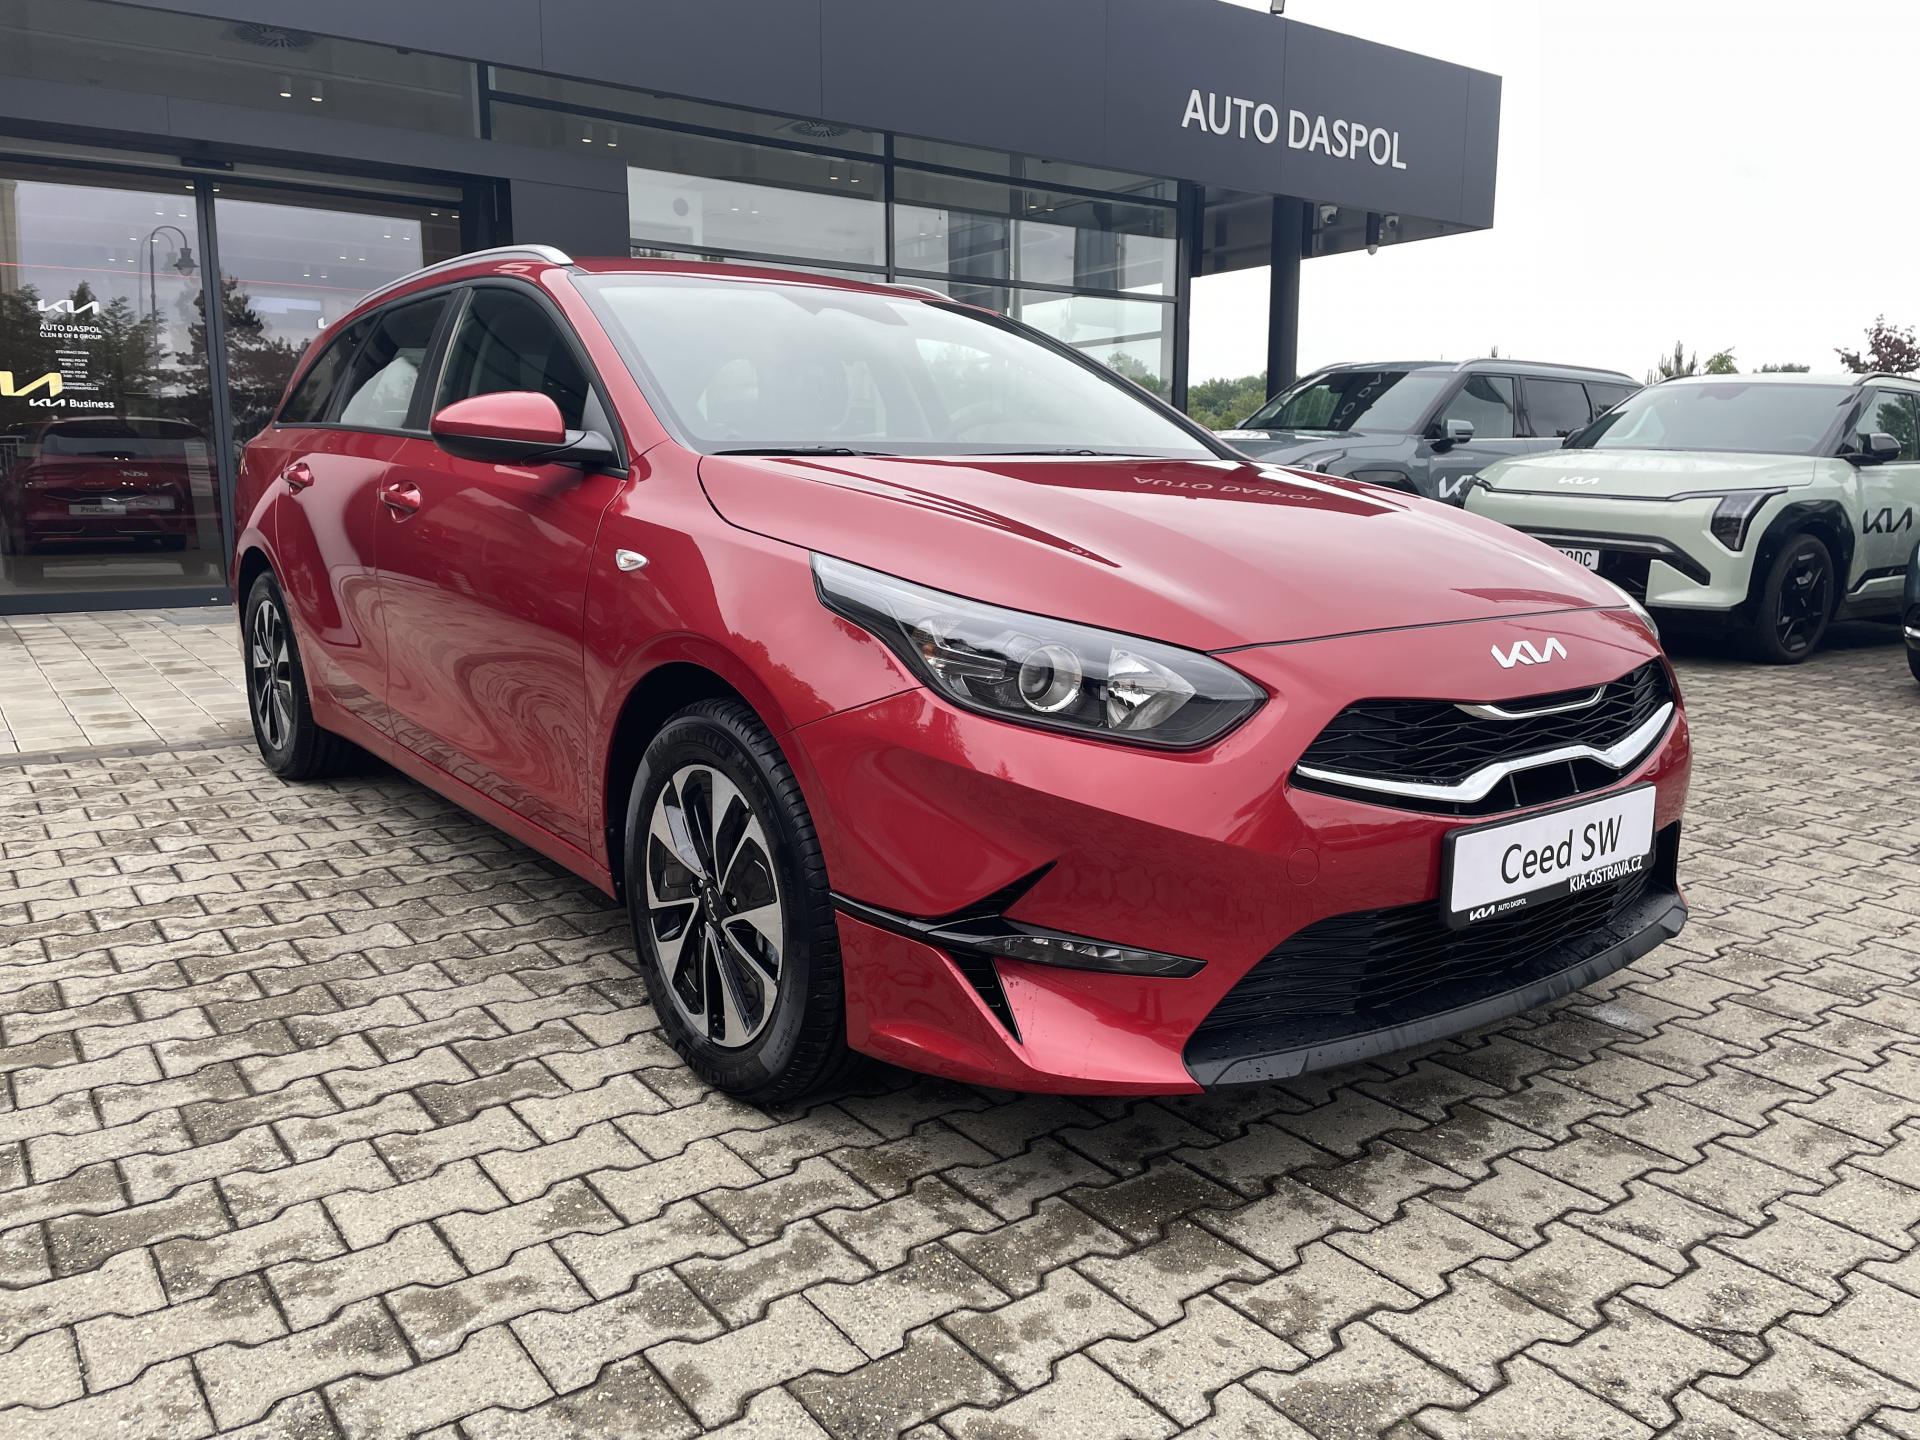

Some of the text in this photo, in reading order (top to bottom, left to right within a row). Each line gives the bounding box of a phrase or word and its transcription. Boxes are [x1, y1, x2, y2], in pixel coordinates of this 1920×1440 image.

[1181, 88, 1407, 170] AUTO DASPOL
[37, 299, 100, 315] KIA
[40, 324, 102, 333] AUTO DASPOL
[69, 399, 115, 409] Business
[1862, 507, 1913, 535] KIA
[1490, 637, 1568, 669] KIA
[1501, 814, 1623, 885] Ceed SW
[1569, 854, 1643, 893] KIA-OSTRAVA.CZ
[1469, 897, 1527, 922] KIA AUTO DASPOL
